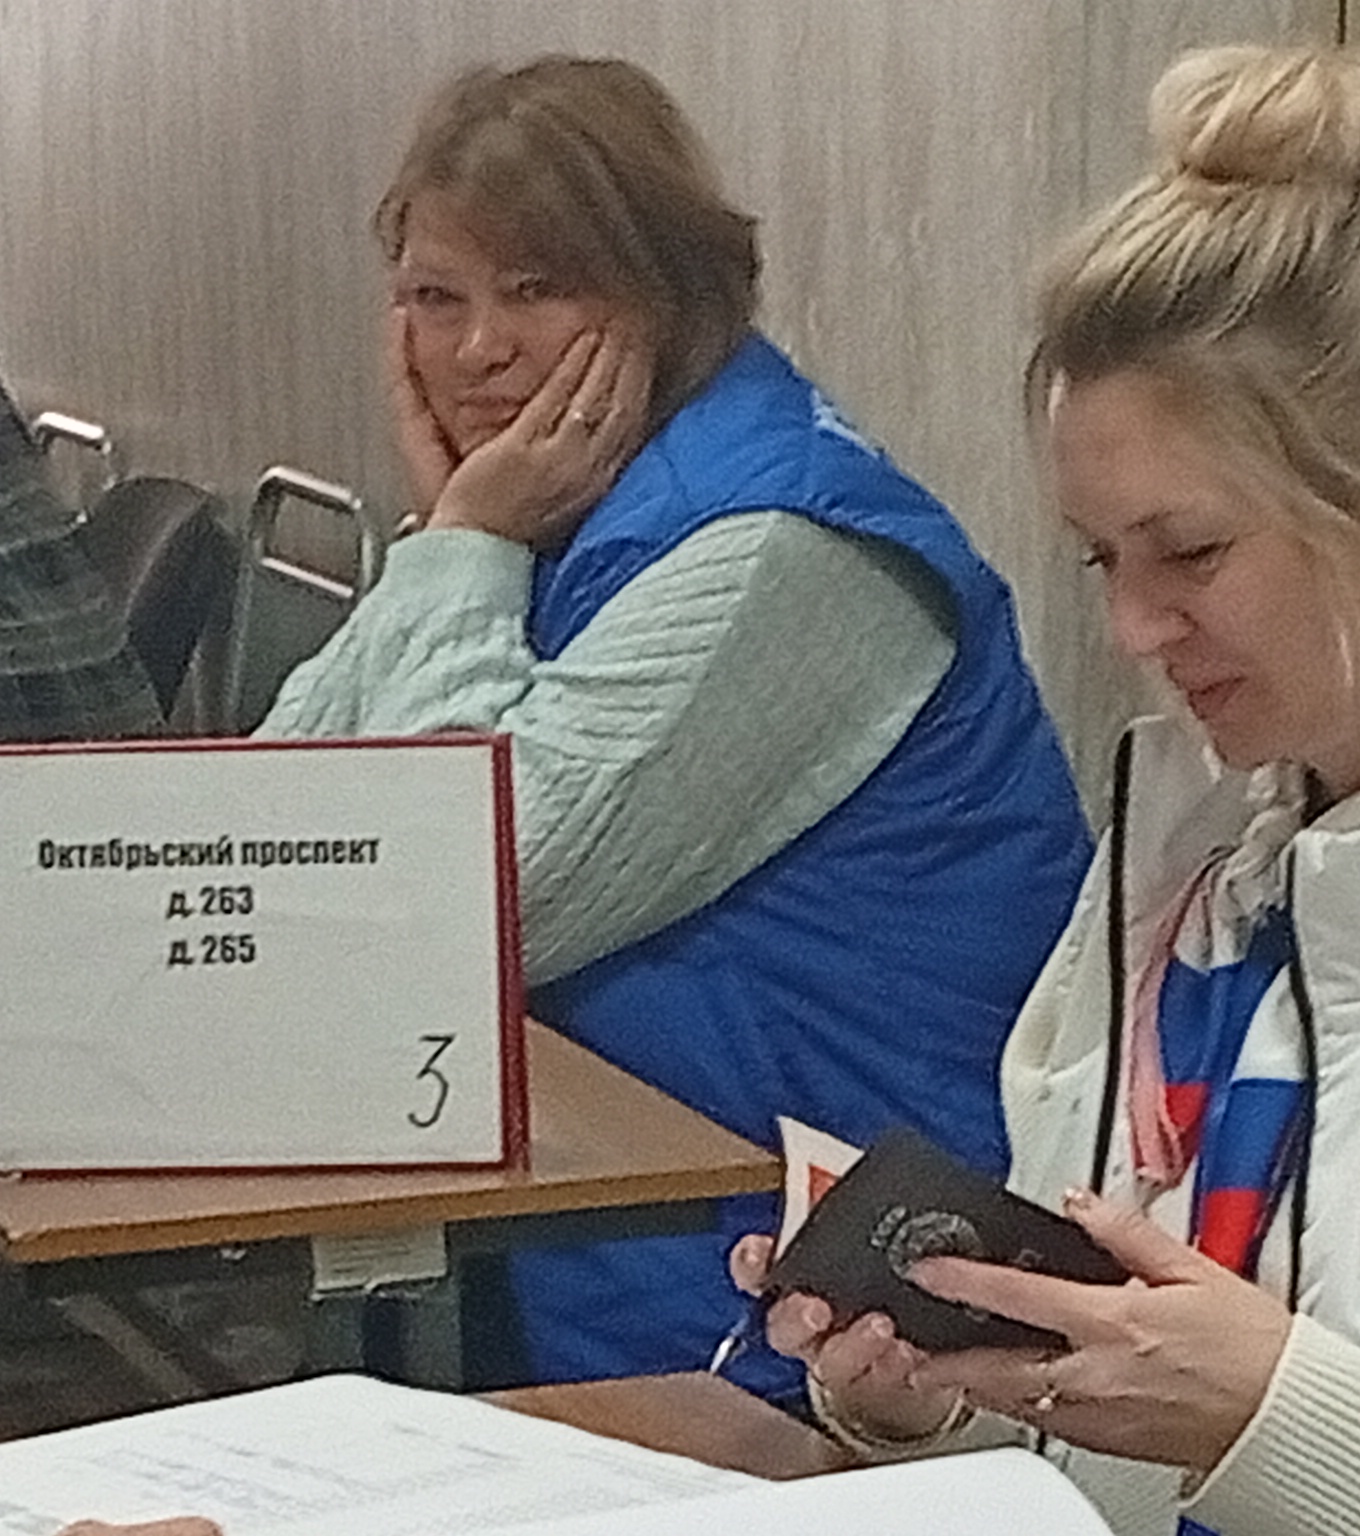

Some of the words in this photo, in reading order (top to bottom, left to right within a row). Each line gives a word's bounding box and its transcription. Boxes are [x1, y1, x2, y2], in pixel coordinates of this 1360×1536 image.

[38, 834, 234, 871] Октябрьский
[240, 838, 380, 868] проспект
[199, 885, 254, 916] 263
[200, 933, 256, 965] 265
[406, 1033, 457, 1129] 3
